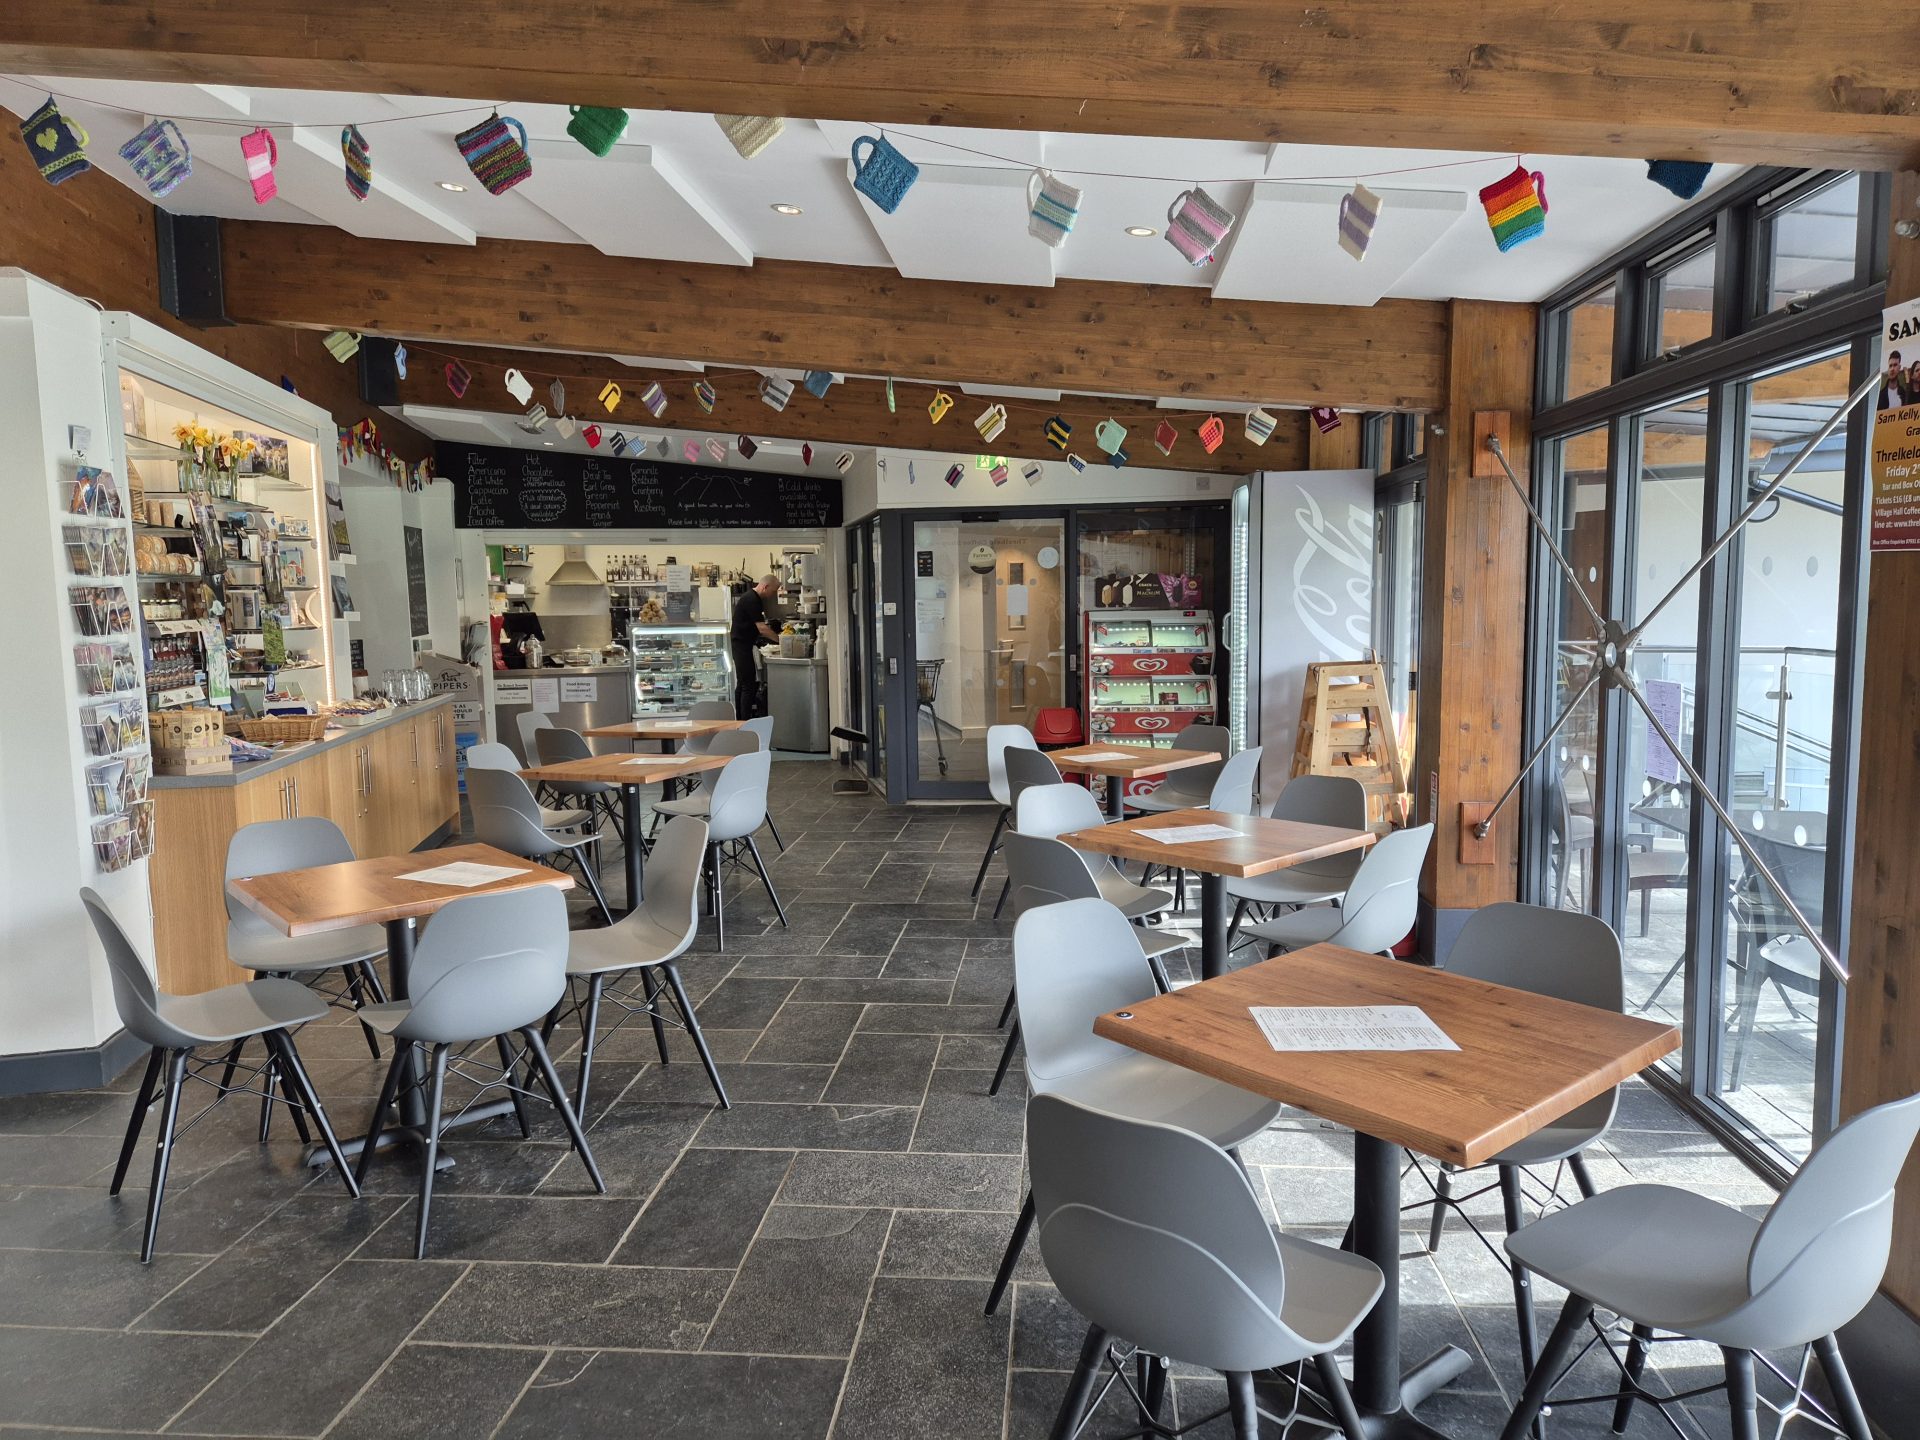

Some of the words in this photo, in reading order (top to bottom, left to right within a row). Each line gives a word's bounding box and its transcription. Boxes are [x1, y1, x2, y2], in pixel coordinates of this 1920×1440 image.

[1878, 413, 1896, 425] Sam
[1898, 407, 1920, 421] Kelly,
[526, 453, 540, 464] Hot
[585, 459, 599, 470] Tea
[468, 465, 506, 475] Americano
[522, 465, 553, 477] Chocolate
[1886, 464, 1911, 478] Friday
[468, 475, 483, 485] Flat
[1891, 481, 1902, 490] and
[1903, 480, 1913, 489] Box
[583, 481, 597, 491] Earl
[600, 481, 616, 493] Grey
[632, 484, 664, 497] Cranberry
[471, 495, 492, 506] Latte
[585, 491, 608, 500] Green
[470, 506, 495, 516] Mocha
[1875, 508, 1892, 517] Village
[467, 516, 483, 526] Iced
[433, 682, 468, 690] PIPERS
